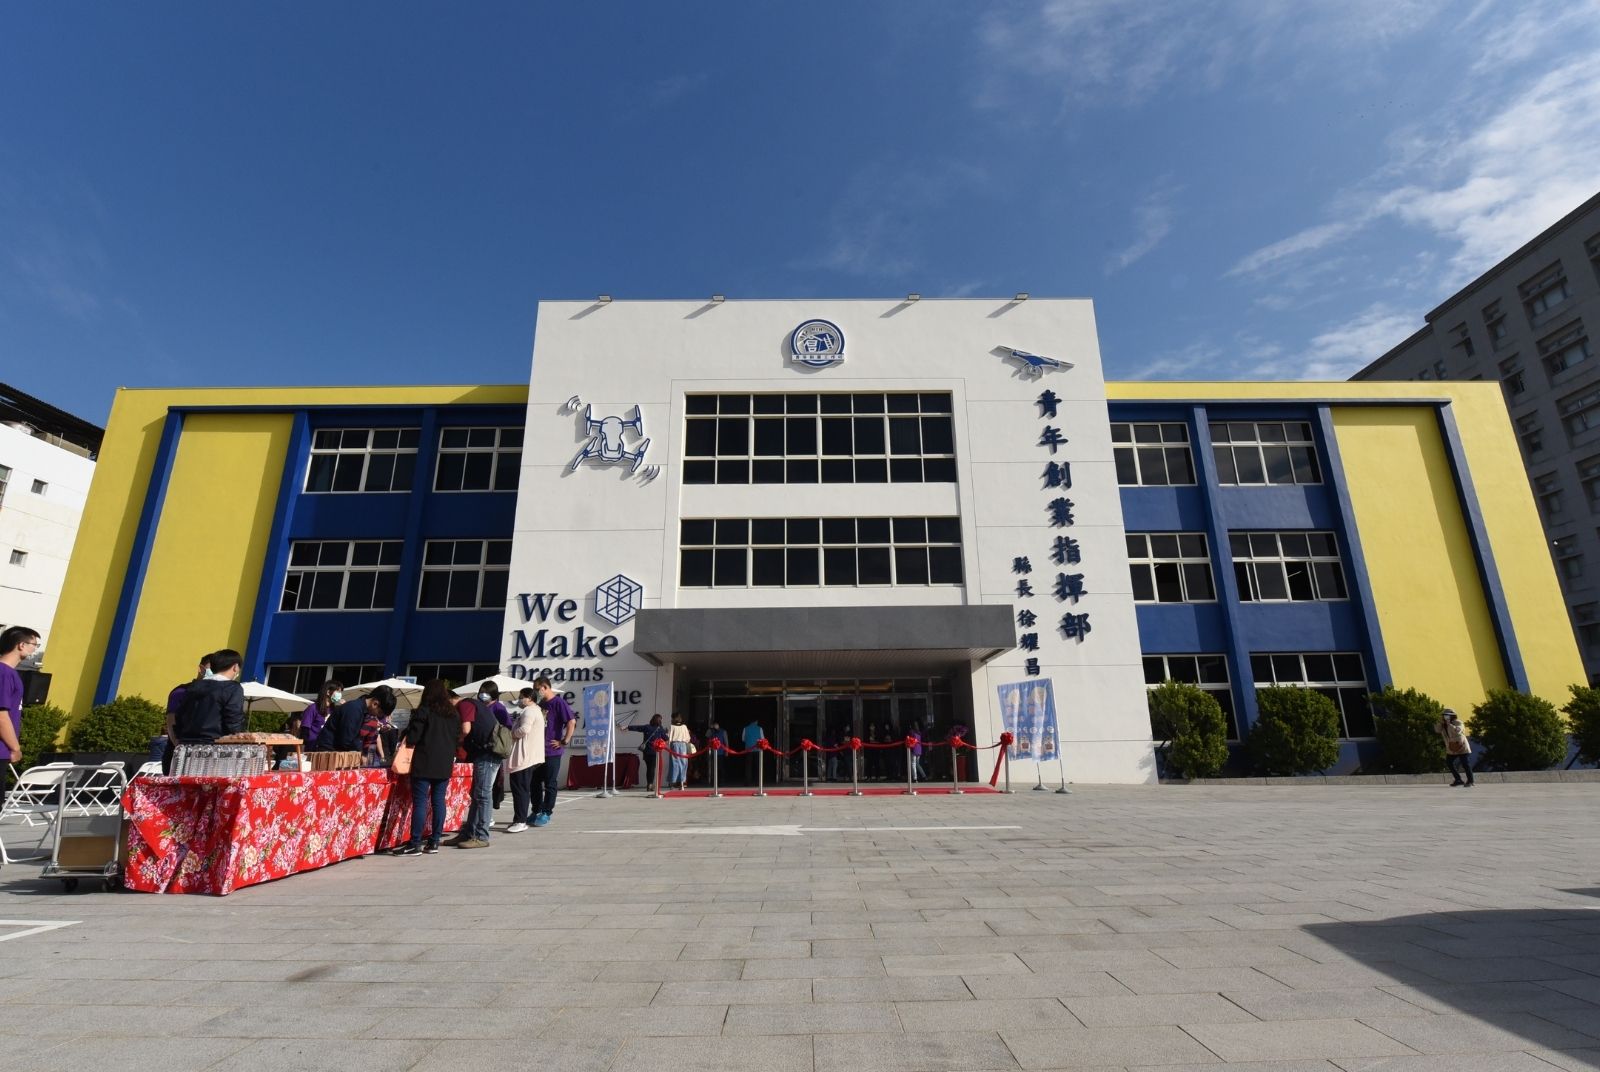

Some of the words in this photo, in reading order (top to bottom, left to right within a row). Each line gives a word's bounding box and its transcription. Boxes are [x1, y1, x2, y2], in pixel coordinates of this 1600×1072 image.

[1036, 389, 1092, 642] 青年創業指揮部
[518, 593, 578, 622] We
[511, 626, 619, 659] Make
[510, 664, 604, 682] Dreams
